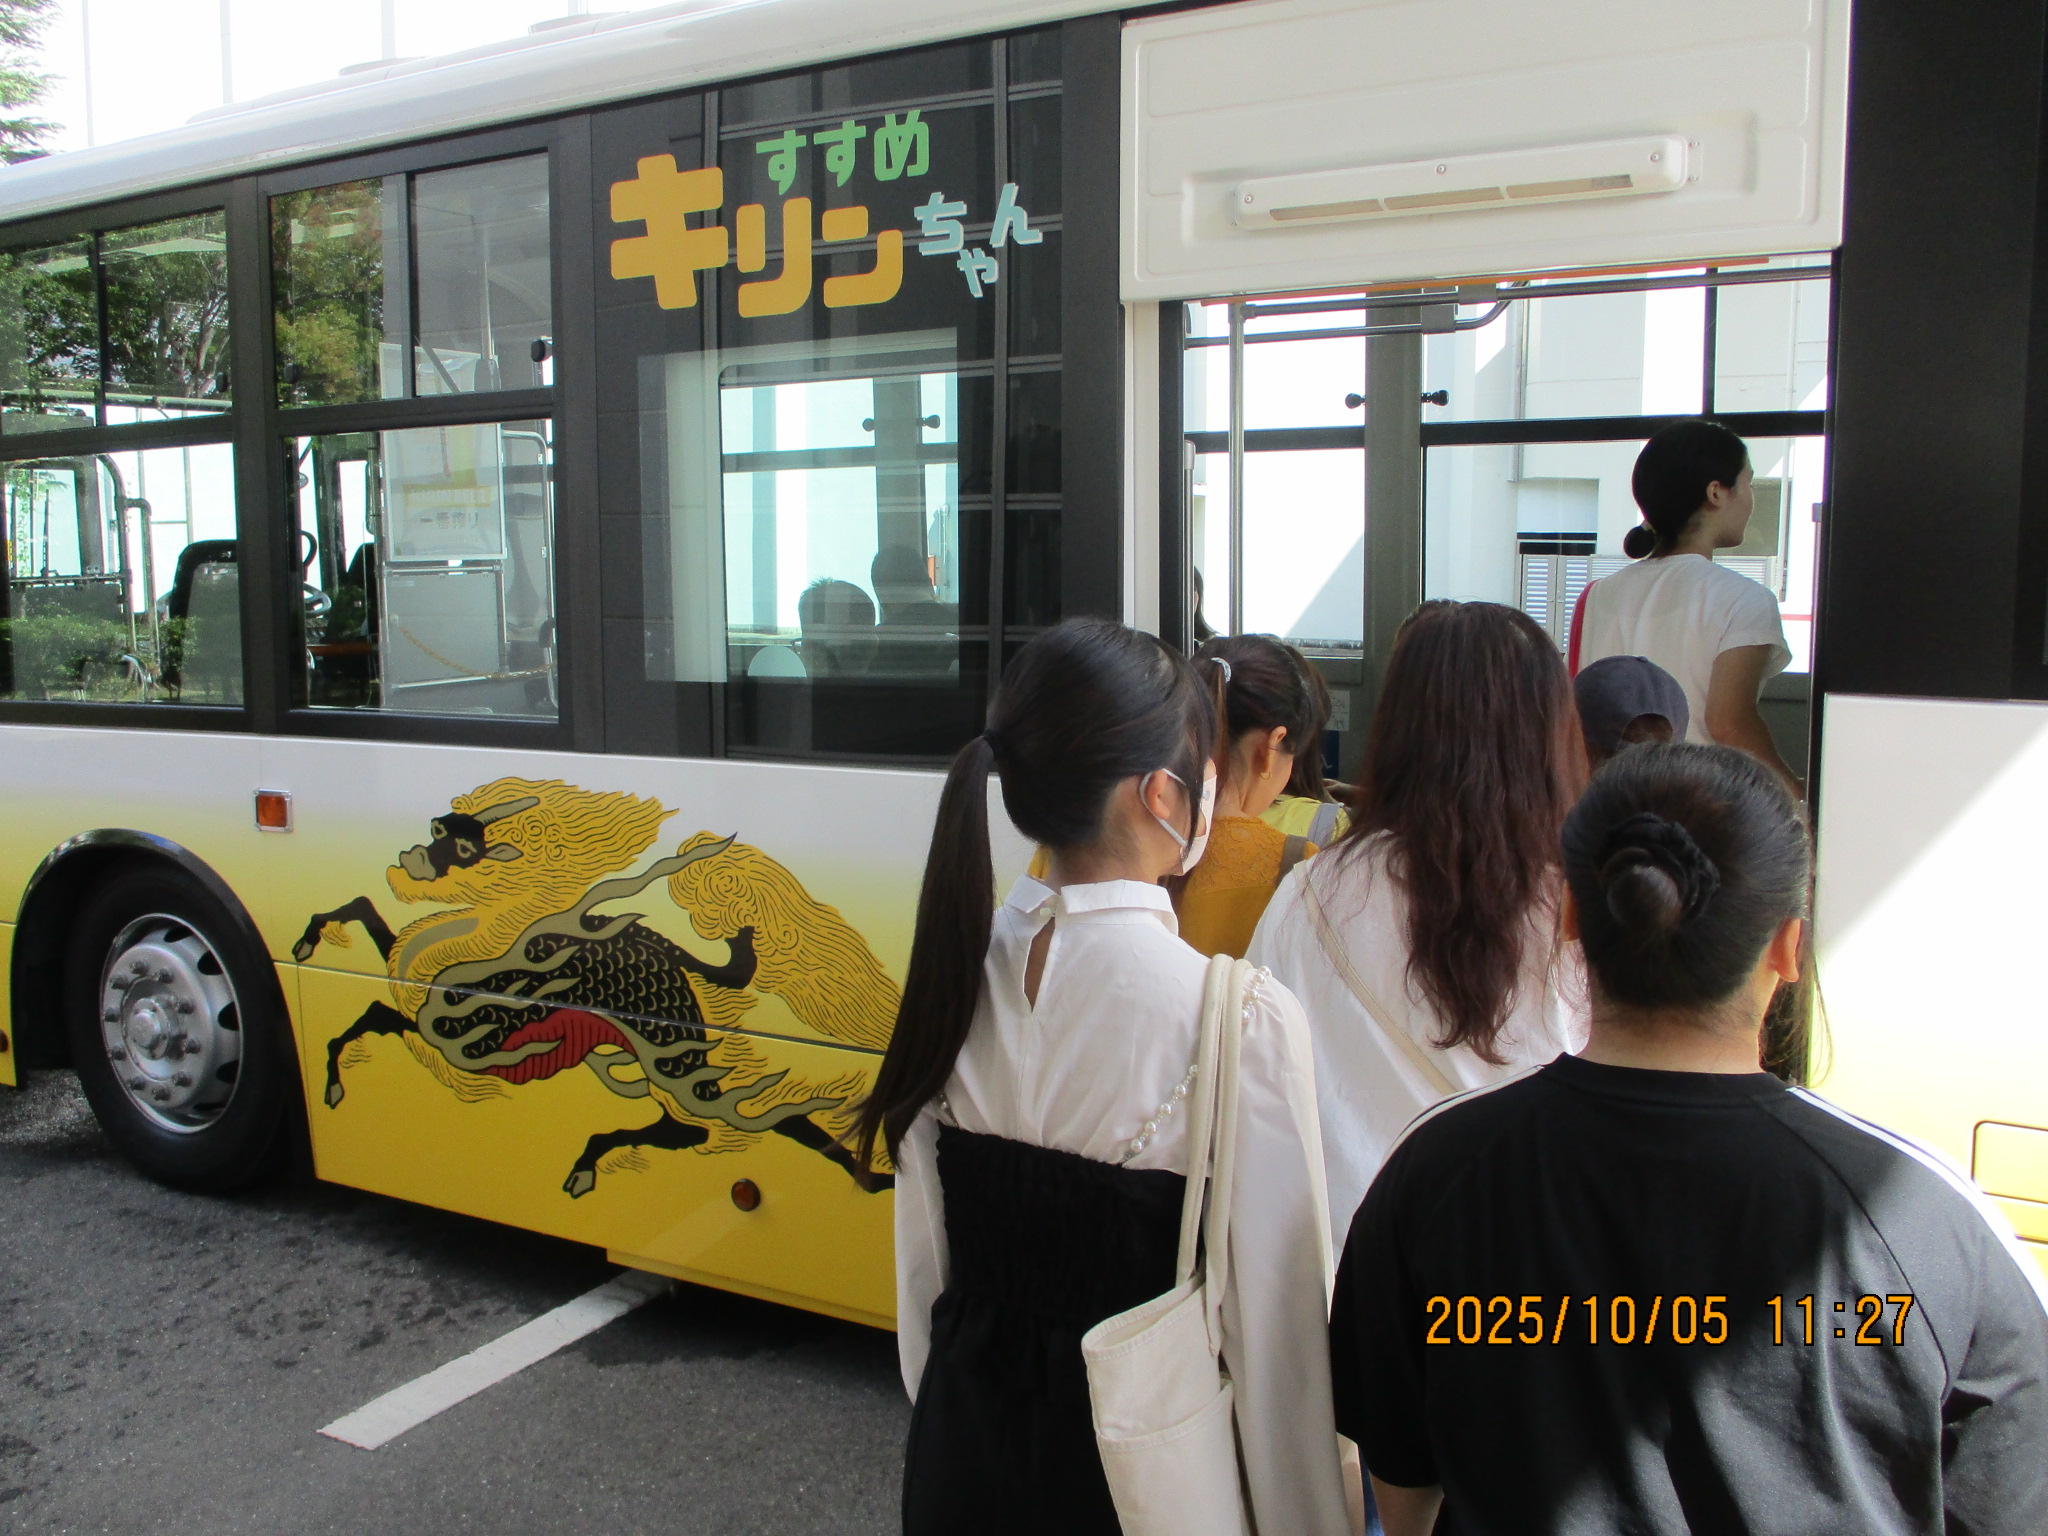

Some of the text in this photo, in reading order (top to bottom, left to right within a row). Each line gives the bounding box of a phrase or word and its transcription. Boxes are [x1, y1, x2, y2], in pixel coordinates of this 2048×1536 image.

[756, 109, 930, 196] すすめ
[610, 153, 1043, 319] キリン ちゃん
